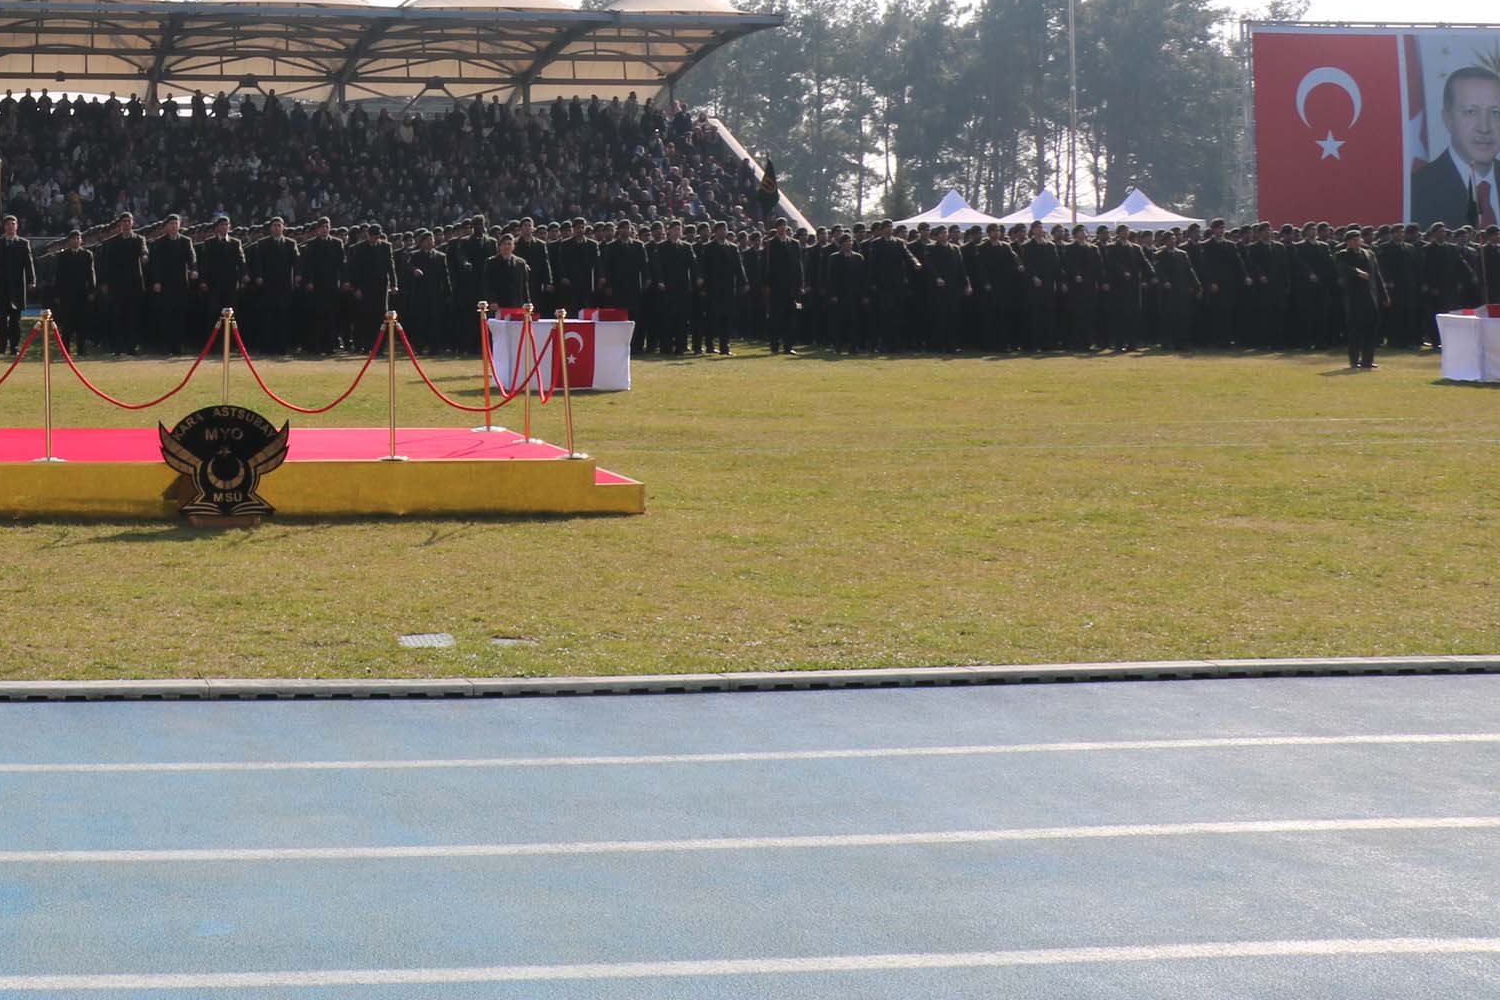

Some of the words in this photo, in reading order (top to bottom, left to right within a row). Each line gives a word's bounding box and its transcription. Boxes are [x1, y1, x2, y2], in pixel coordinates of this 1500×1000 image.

[172, 413, 204, 441] KARA
[213, 407, 276, 437] ASTSUBAY
[204, 427, 243, 441] MYO
